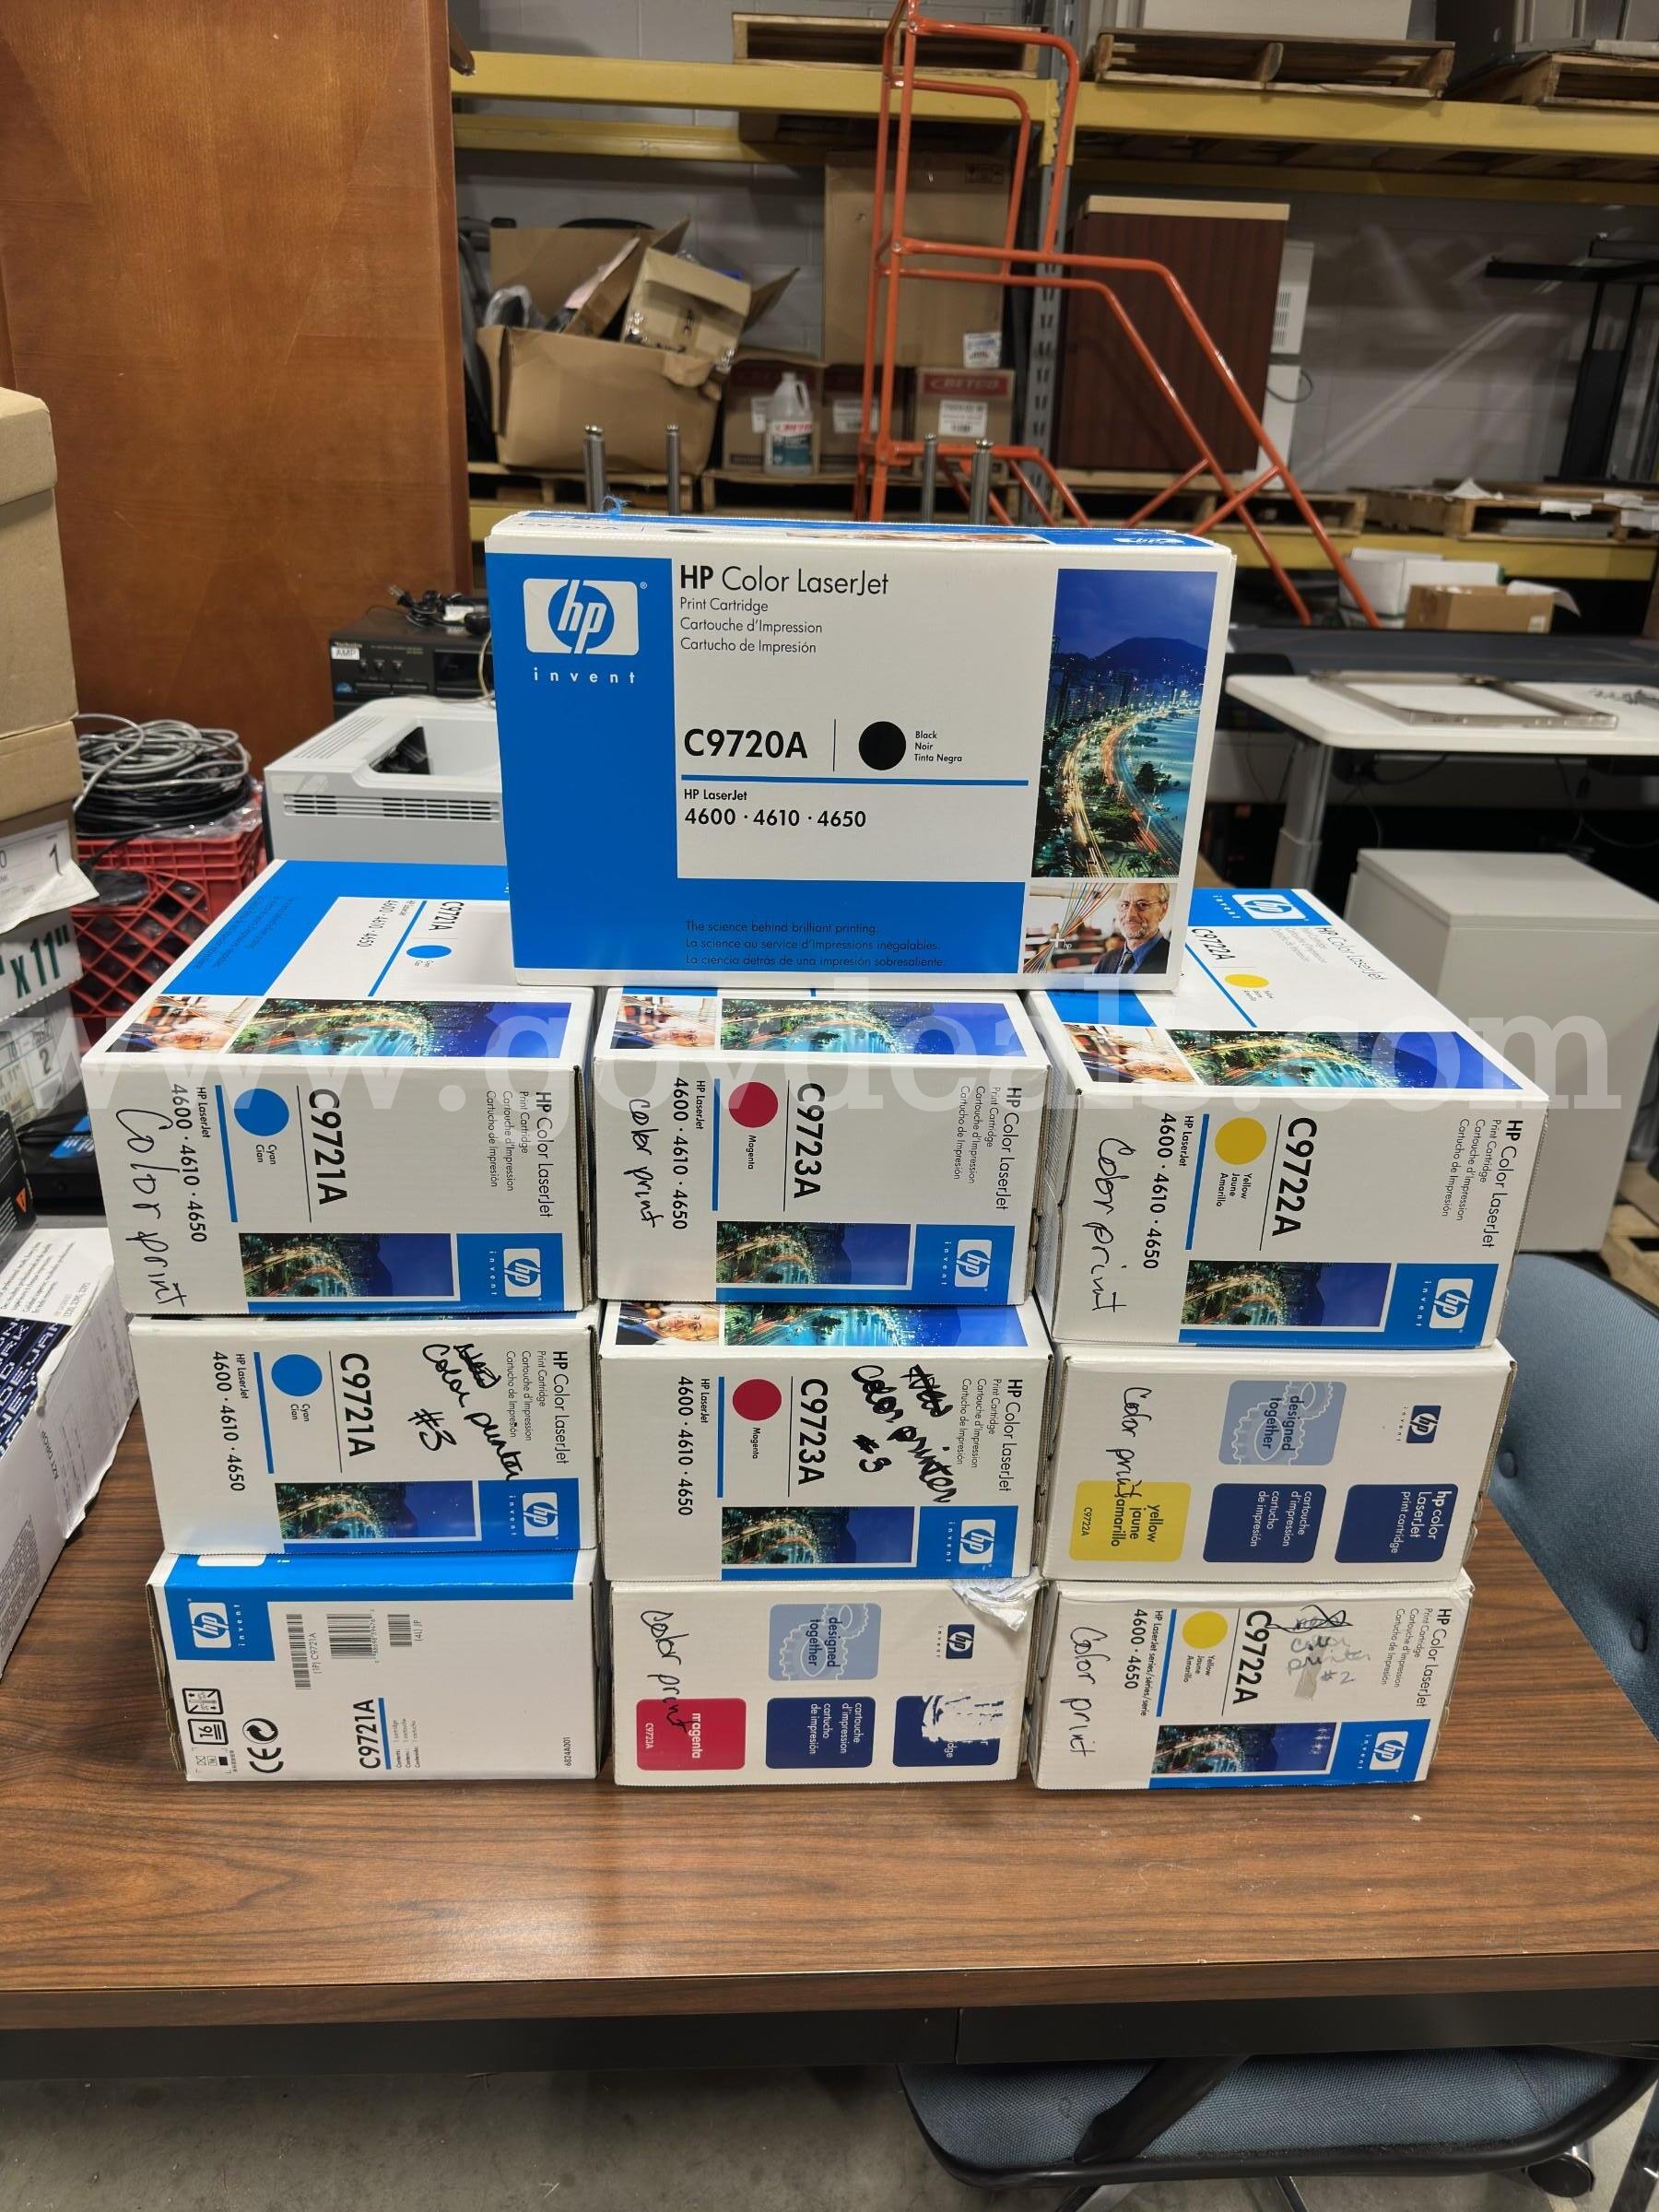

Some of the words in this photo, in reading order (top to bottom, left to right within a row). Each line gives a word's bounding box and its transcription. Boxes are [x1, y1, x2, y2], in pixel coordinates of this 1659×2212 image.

[681, 565, 713, 589] HP
[722, 565, 790, 592] Color
[798, 568, 888, 596] LaserJet
[680, 596, 706, 610] Print
[710, 597, 769, 616] Cartridge
[680, 617, 743, 631] Cartouche
[747, 618, 822, 636] d'Impression
[335, 648, 357, 657] AMP
[680, 637, 735, 651] Cartucho
[739, 638, 755, 652] de
[759, 640, 816, 655] Impresión
[534, 667, 635, 684] invent
[684, 728, 807, 759] C9720A
[915, 730, 937, 739] Black
[915, 742, 934, 750] Noir
[914, 753, 934, 761] Tinta
[936, 754, 962, 764] Negra
[684, 789, 700, 799] HP
[703, 789, 747, 801] LaserJet
[685, 808, 735, 825] 4600
[753, 809, 800, 826] 4610
[817, 810, 865, 827] 4650
[429, 901, 465, 931] C9721A
[686, 921, 704, 932] The
[708, 922, 747, 932] science
[751, 922, 788, 933] behind
[792, 923, 830, 934] brilliant
[1191, 928, 1236, 959] C9722A
[171, 1084, 193, 1129] 4600
[196, 1088, 207, 1100] HP
[535, 1092, 552, 1112] HP
[673, 1077, 688, 1121] 4600
[1006, 1088, 1022, 1108] HP
[198, 1102, 211, 1138] LaserJet
[536, 1117, 555, 1159] Color
[1002, 1112, 1019, 1153] Color
[1157, 1112, 1177, 1158] 4600
[1184, 1116, 1194, 1128] HP
[1489, 1120, 1502, 1138] Print
[1506, 1120, 1524, 1141] HP
[255, 1144, 265, 1162] Cian
[266, 1144, 277, 1165] Cyan
[309, 1089, 347, 1205] C9721A
[673, 1135, 688, 1175] 4610
[746, 1135, 757, 1170] Magenta
[794, 1083, 825, 1198] C9723A
[1179, 1132, 1193, 1167] LaserJet
[1453, 1119, 1470, 1159] Cartucho
[1467, 1119, 1486, 1165] Cartouche
[180, 1145, 200, 1185] 4610
[1272, 1118, 1317, 1236] C9722A
[1478, 1141, 1497, 1182] Cartridge
[1495, 1146, 1517, 1188] Color
[538, 1163, 555, 1218] LaserJet
[995, 1158, 1015, 1210] LaserJet
[1150, 1172, 1170, 1213] 4610
[1216, 1172, 1229, 1206] Amarillo
[1230, 1172, 1241, 1196] Jaune
[1241, 1173, 1253, 1199] Yellow
[1456, 1167, 1476, 1221] d'Impression
[187, 1200, 207, 1242] 4650
[673, 1189, 688, 1230] 4650
[1482, 1193, 1508, 1248] LaserJet
[1143, 1228, 1162, 1268] 4650
[489, 1251, 498, 1295] invent
[213, 1351, 232, 1392] 4600
[553, 1351, 568, 1370] HP
[340, 1353, 375, 1456] C9721A
[553, 1373, 571, 1411] Color
[678, 1376, 693, 1416] 4600
[1007, 1380, 1023, 1397] HP
[220, 1405, 239, 1441] 4610
[798, 1379, 829, 1485] C9723A
[1004, 1402, 1020, 1439] Color
[1262, 1396, 1282, 1450] together
[1281, 1395, 1305, 1452] designed
[555, 1415, 571, 1464] LaserJet
[678, 1430, 693, 1465] 4610
[750, 1428, 760, 1459] Magenta
[227, 1454, 245, 1491] 4650
[998, 1443, 1018, 1491] LaserJet
[678, 1478, 693, 1515] 4650
[1258, 1491, 1267, 1502] de
[1266, 1491, 1279, 1530] cartucho
[1297, 1491, 1312, 1535] cartouche
[1401, 1491, 1410, 1512] print
[1409, 1491, 1432, 1537] LaserJet
[1431, 1491, 1452, 1506] hp
[1080, 1506, 1093, 1536] C9722A
[1111, 1497, 1125, 1547] amarillo
[1130, 1506, 1146, 1540] jaune
[1147, 1504, 1164, 1543] yellow
[1282, 1491, 1298, 1547] d'impression
[1389, 1513, 1406, 1553] cartridge
[1428, 1509, 1444, 1539] color
[233, 1605, 245, 1646] invent
[1131, 1608, 1147, 1644] 4600
[1437, 1608, 1453, 1625] HP
[308, 1632, 319, 1660] C9721A
[807, 1618, 820, 1666] together
[827, 1617, 841, 1668] designed
[1232, 1610, 1273, 1704] C9722A
[1427, 1628, 1447, 1663] Color
[1124, 1655, 1142, 1688] 4650
[1183, 1655, 1194, 1683] Amarillo
[1205, 1655, 1216, 1677] Yellow
[1416, 1665, 1439, 1707] LaserJet
[198, 1725, 213, 1737] 16
[353, 1700, 381, 1769] C9721A
[688, 1713, 703, 1759] magenta
[840, 1703, 850, 1753] d'impression
[853, 1702, 865, 1743] cartouche
